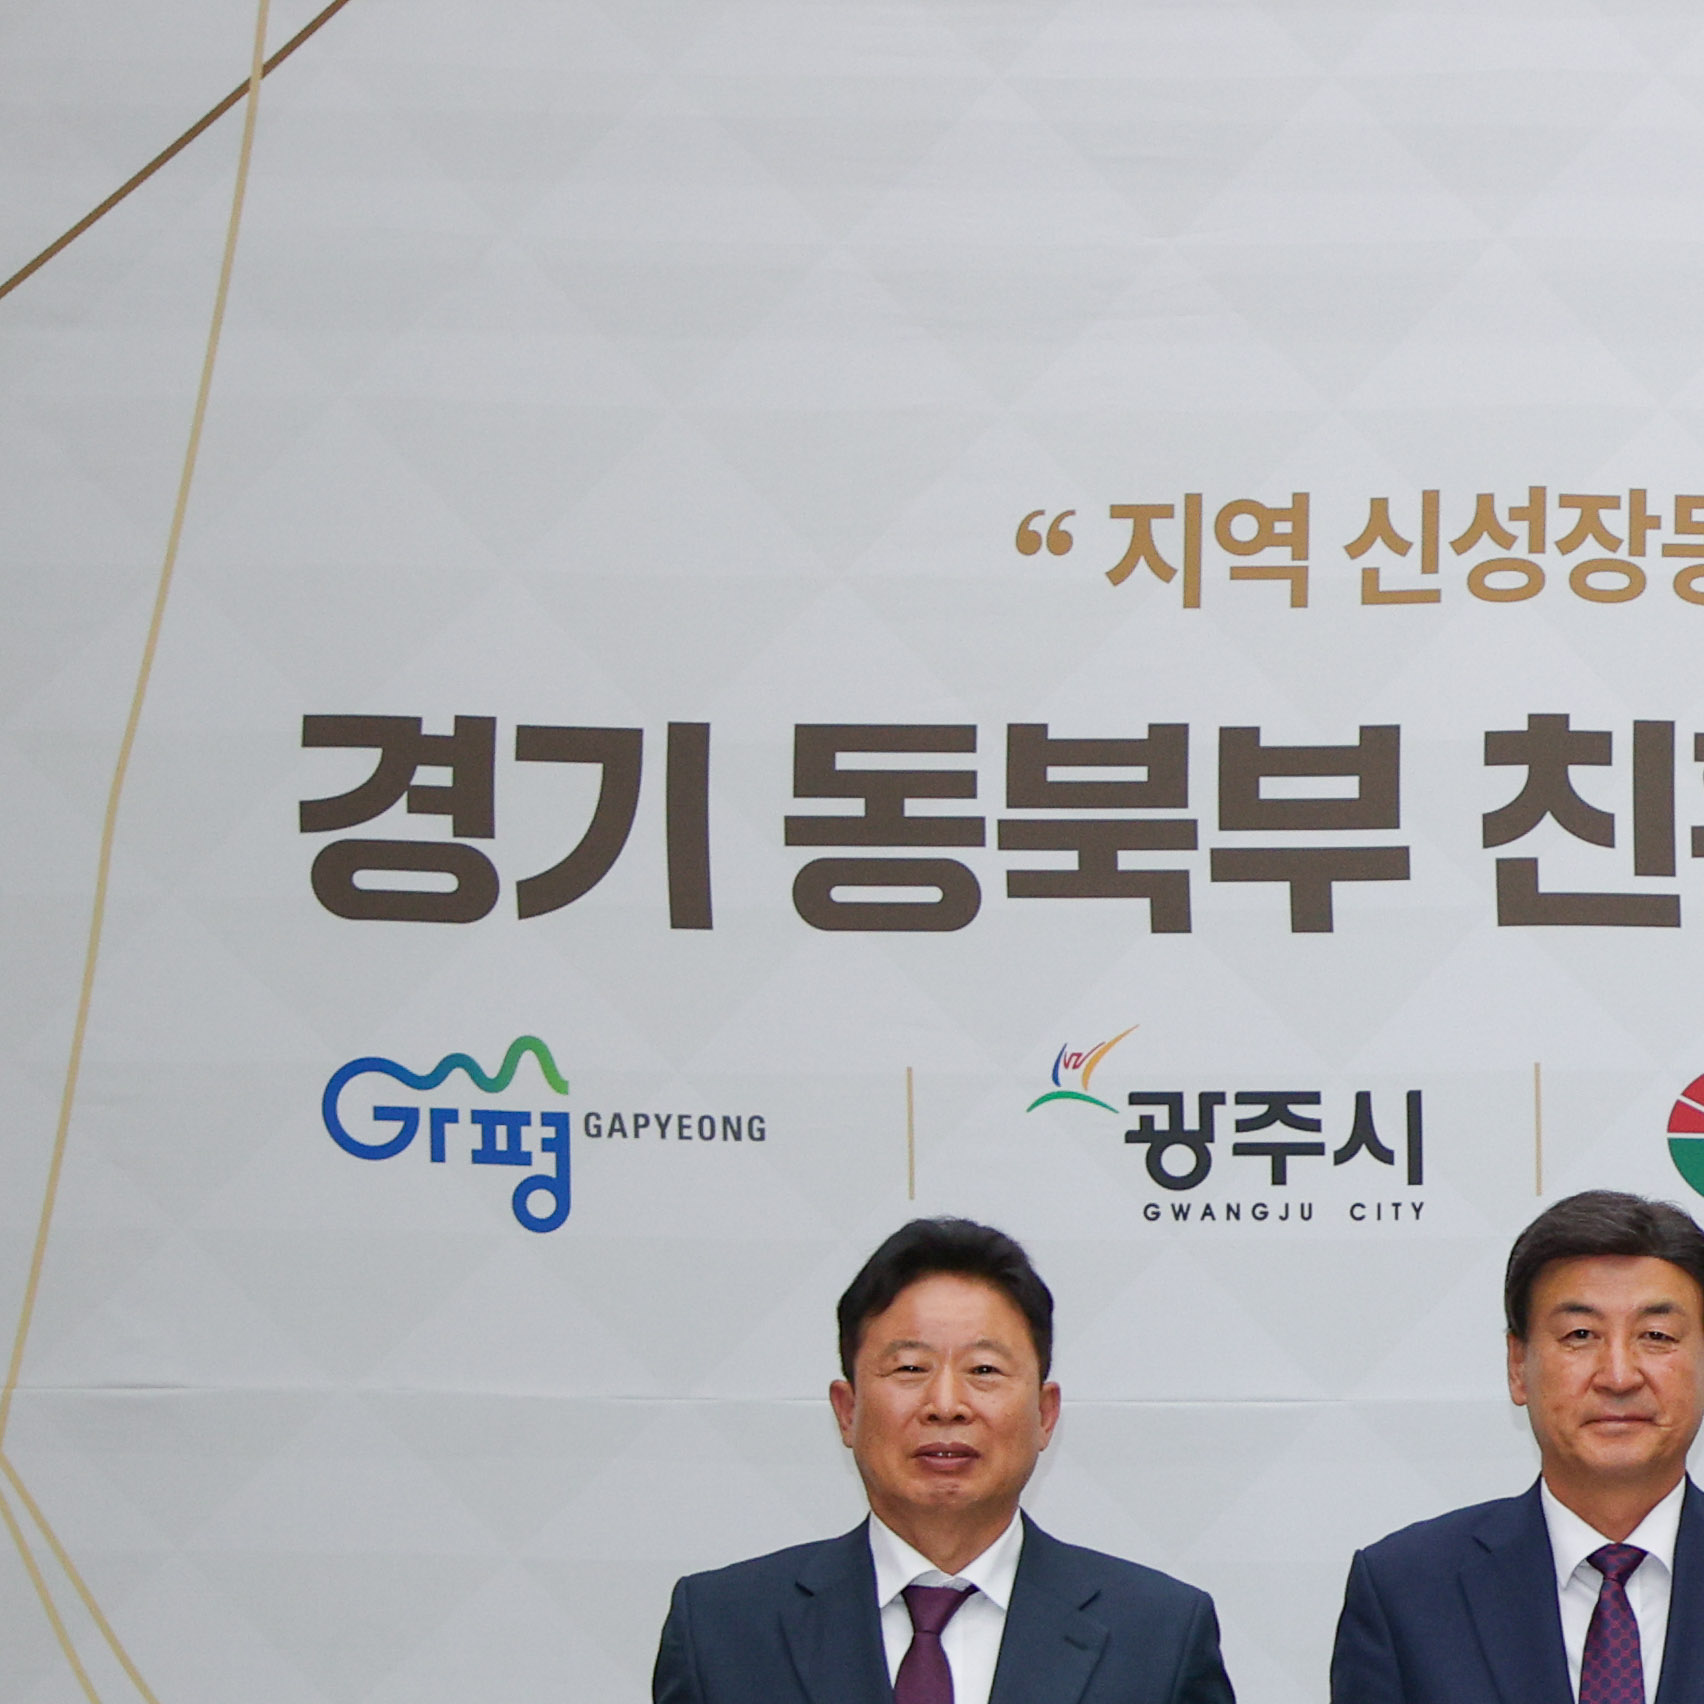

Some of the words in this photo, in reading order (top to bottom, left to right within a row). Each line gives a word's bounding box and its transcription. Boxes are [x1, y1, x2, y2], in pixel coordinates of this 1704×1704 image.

[1105, 493, 1309, 608] 지역
[299, 714, 713, 930] 경기
[784, 723, 1410, 933] 동북부
[584, 1112, 765, 1141] GAPYEONG
[1125, 1090, 1423, 1191] 광주시
[1143, 1203, 1312, 1221] GWANGJU
[1350, 1202, 1423, 1221] CITY
